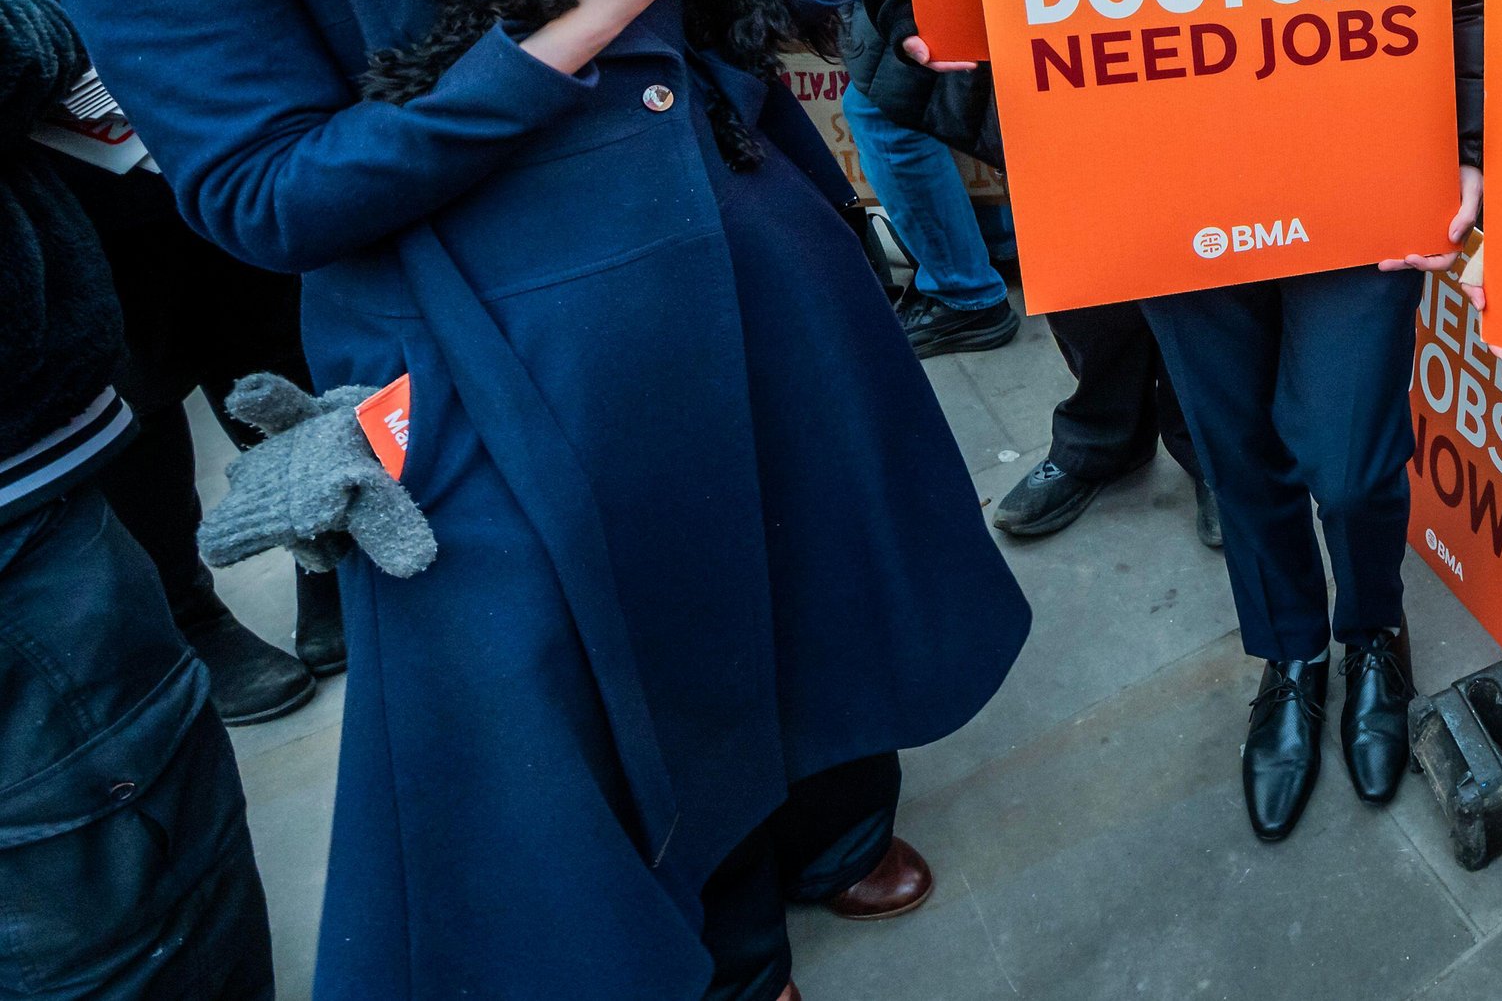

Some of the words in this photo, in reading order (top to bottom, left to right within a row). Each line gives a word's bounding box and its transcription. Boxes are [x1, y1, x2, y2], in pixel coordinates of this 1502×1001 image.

[1030, 22, 1238, 92] NEED
[1255, 4, 1419, 81] JOBS
[1231, 217, 1310, 253] BMA
[1437, 540, 1464, 582] BMA
